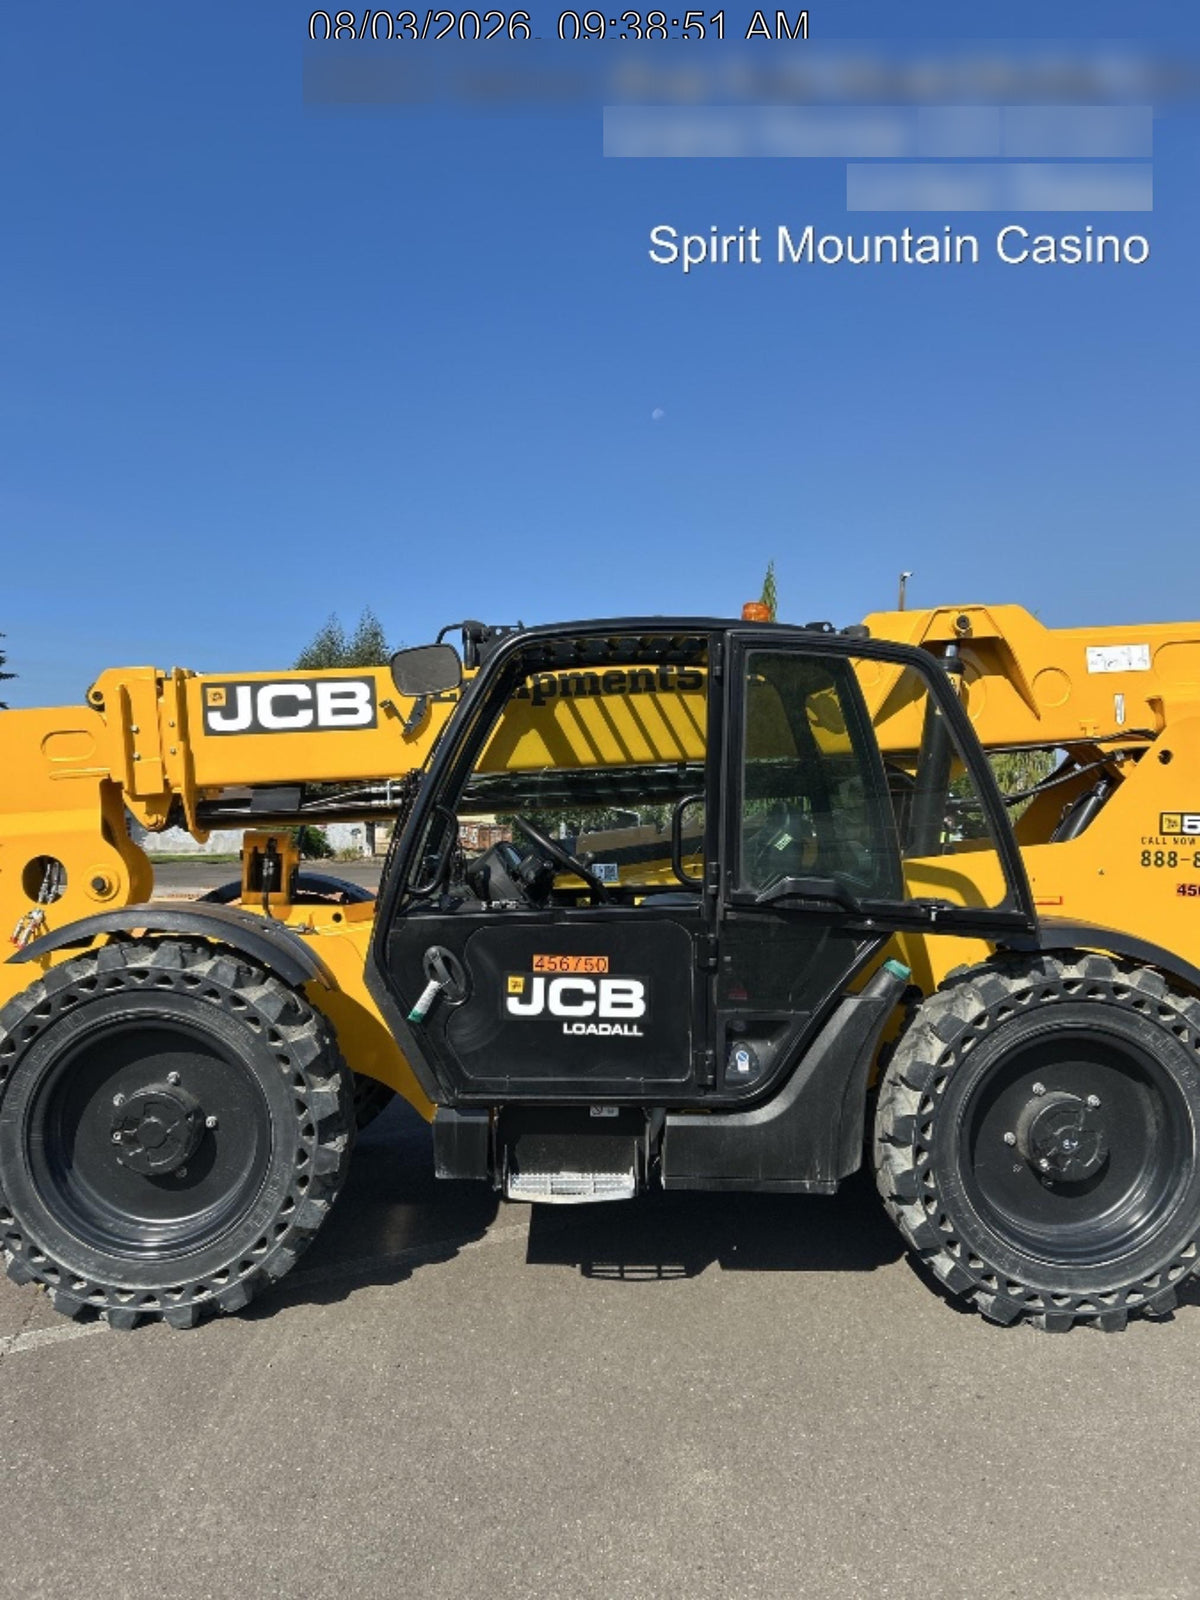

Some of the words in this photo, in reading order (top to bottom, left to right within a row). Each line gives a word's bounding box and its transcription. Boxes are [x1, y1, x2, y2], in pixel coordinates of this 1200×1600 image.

[207, 681, 374, 732] JCB
[1177, 884, 1200, 897] 45
[507, 978, 646, 1018] JCB
[563, 1022, 643, 1036] LOADALL
